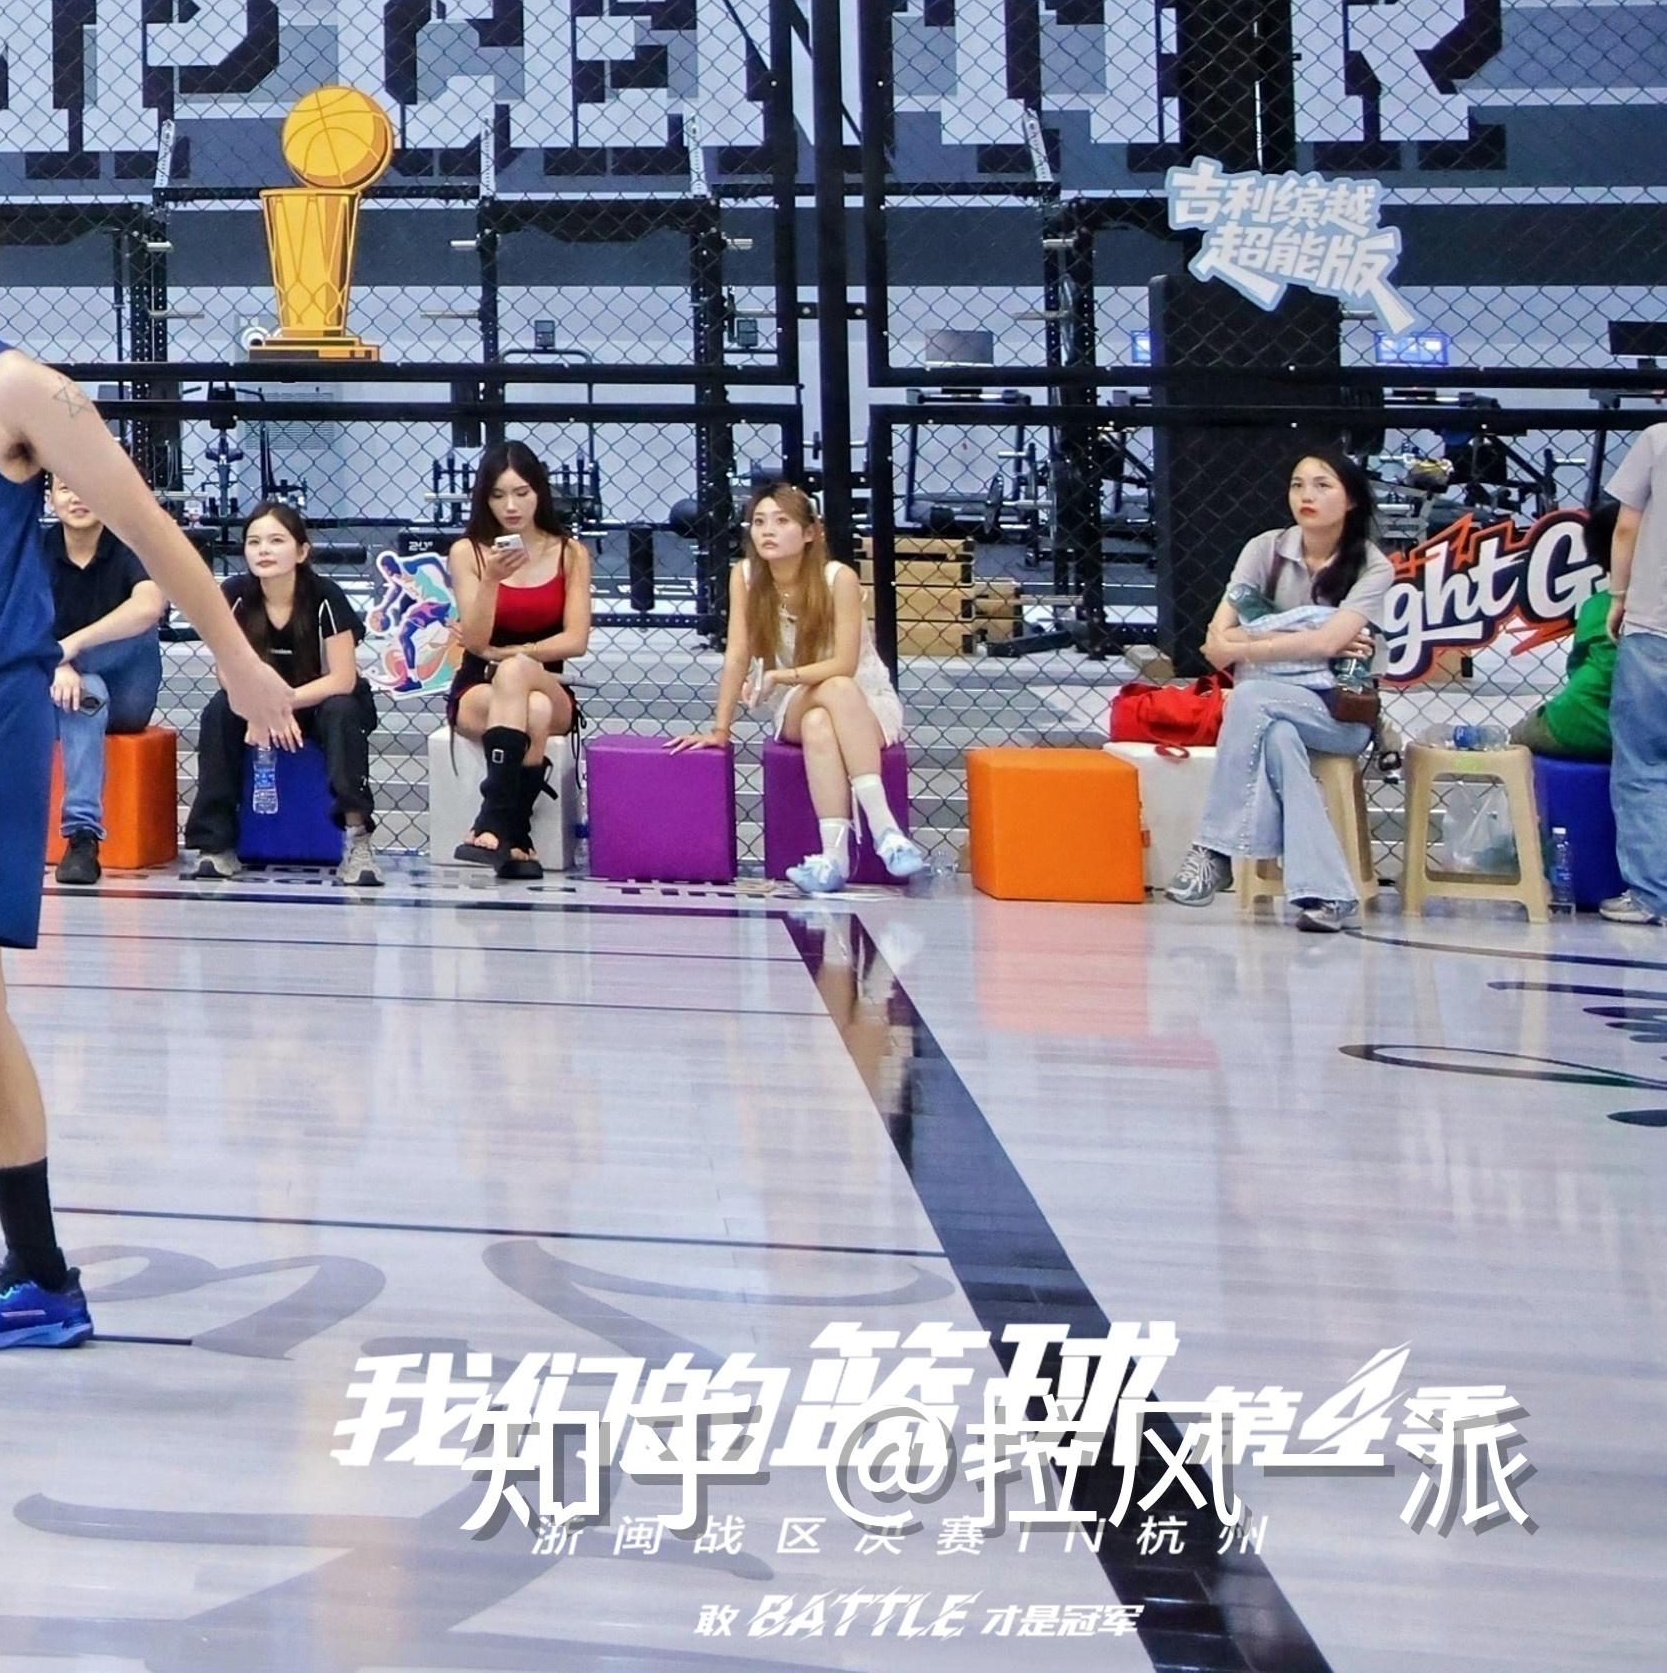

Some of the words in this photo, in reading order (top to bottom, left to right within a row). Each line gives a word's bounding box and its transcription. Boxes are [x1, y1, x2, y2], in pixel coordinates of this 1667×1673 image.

[1172, 162, 1376, 239] 吉利缤越
[1196, 221, 1415, 335] 超能版
